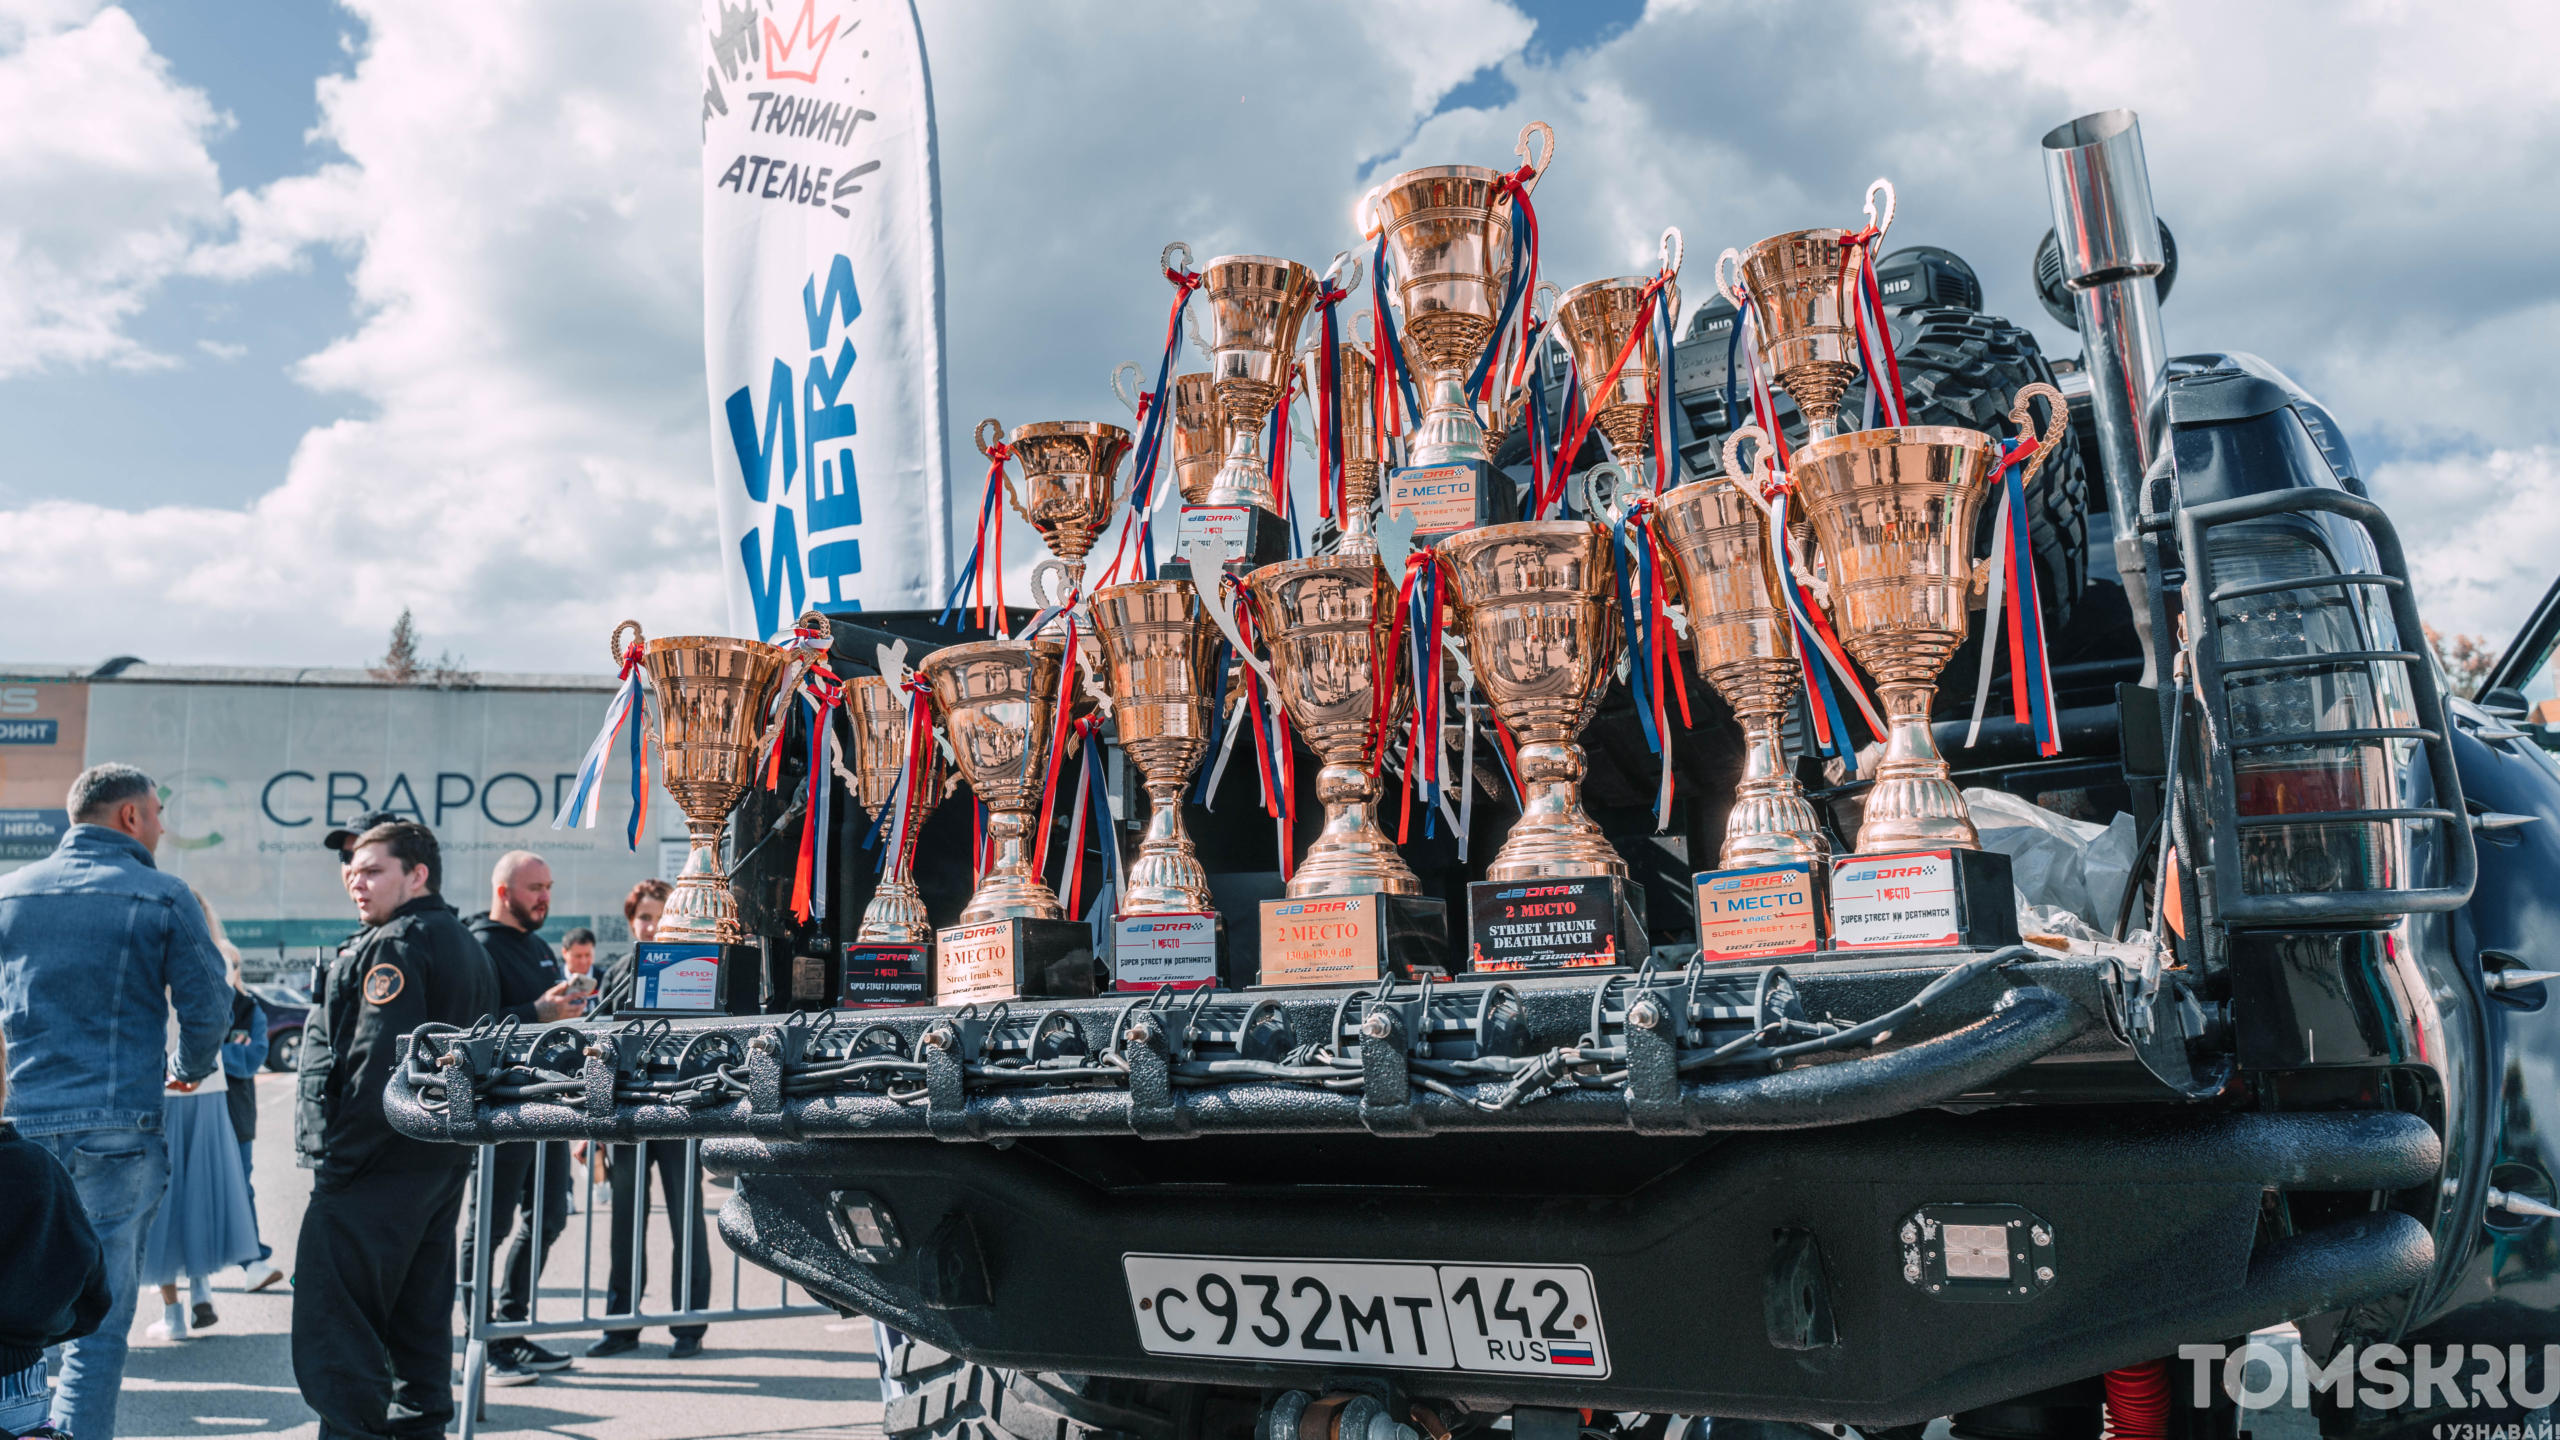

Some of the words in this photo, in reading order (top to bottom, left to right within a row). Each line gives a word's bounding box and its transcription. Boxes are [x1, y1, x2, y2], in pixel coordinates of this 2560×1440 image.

[747, 91, 877, 148] ТЮНИНГ
[717, 154, 833, 207] АТЕЛЬЕ
[1883, 279, 1911, 295] HID
[1402, 469, 1455, 480] dBDRA
[1397, 488, 1408, 498] 2
[1413, 482, 1470, 497] МЕСТО
[1423, 508, 1454, 516] STREET
[1846, 866, 1923, 882] dBDRA
[1712, 875, 1783, 891] dBDRA
[1495, 885, 1569, 899] dBDRA
[1876, 888, 1882, 902] 1
[1884, 886, 1910, 902] МЕСТО
[1275, 901, 1347, 915] dBDRA
[1505, 905, 1515, 918] 2
[1520, 901, 1577, 917] МЕСТО
[1710, 901, 1718, 914] 1
[1727, 892, 1803, 912] МЕСТО
[1743, 914, 1773, 923] класс
[1840, 914, 1863, 926] SUPER
[1864, 912, 1890, 924] STREET
[1905, 908, 1950, 922] DEATHMATCH
[942, 926, 997, 943] dBDRA
[1126, 923, 1192, 933] dBDRA
[1278, 927, 1286, 942] 2
[1291, 922, 1359, 942] МЕСТО
[1489, 922, 1542, 936] STREET
[1547, 919, 1597, 933] TRUNK
[1711, 929, 1743, 938] SUPER
[1746, 925, 1784, 935] STREET
[1151, 939, 1156, 949] 1
[1158, 938, 1180, 949] МЕСТО
[1493, 931, 1593, 949] DEATHMATCH
[854, 953, 909, 961] dBDRA
[943, 953, 950, 967] 3
[954, 945, 1006, 966] МЕСТО
[1120, 958, 1139, 967] SUPER
[1140, 958, 1162, 967] STREET
[1174, 956, 1212, 966] DEATHMATCH
[1286, 948, 1337, 961] 130.0-139.9
[1338, 947, 1353, 958] dB
[880, 968, 898, 977] МЕСТО
[946, 974, 968, 984] Street
[969, 969, 991, 981] Trunk
[992, 968, 1004, 978] 5K
[850, 982, 865, 991] SUPER
[866, 982, 885, 991] STREET
[890, 983, 922, 991] DEATHMATCH
[1155, 1272, 1434, 1356] С932МТ
[1451, 1276, 1578, 1341] 142
[1488, 1339, 1548, 1363] RUS
